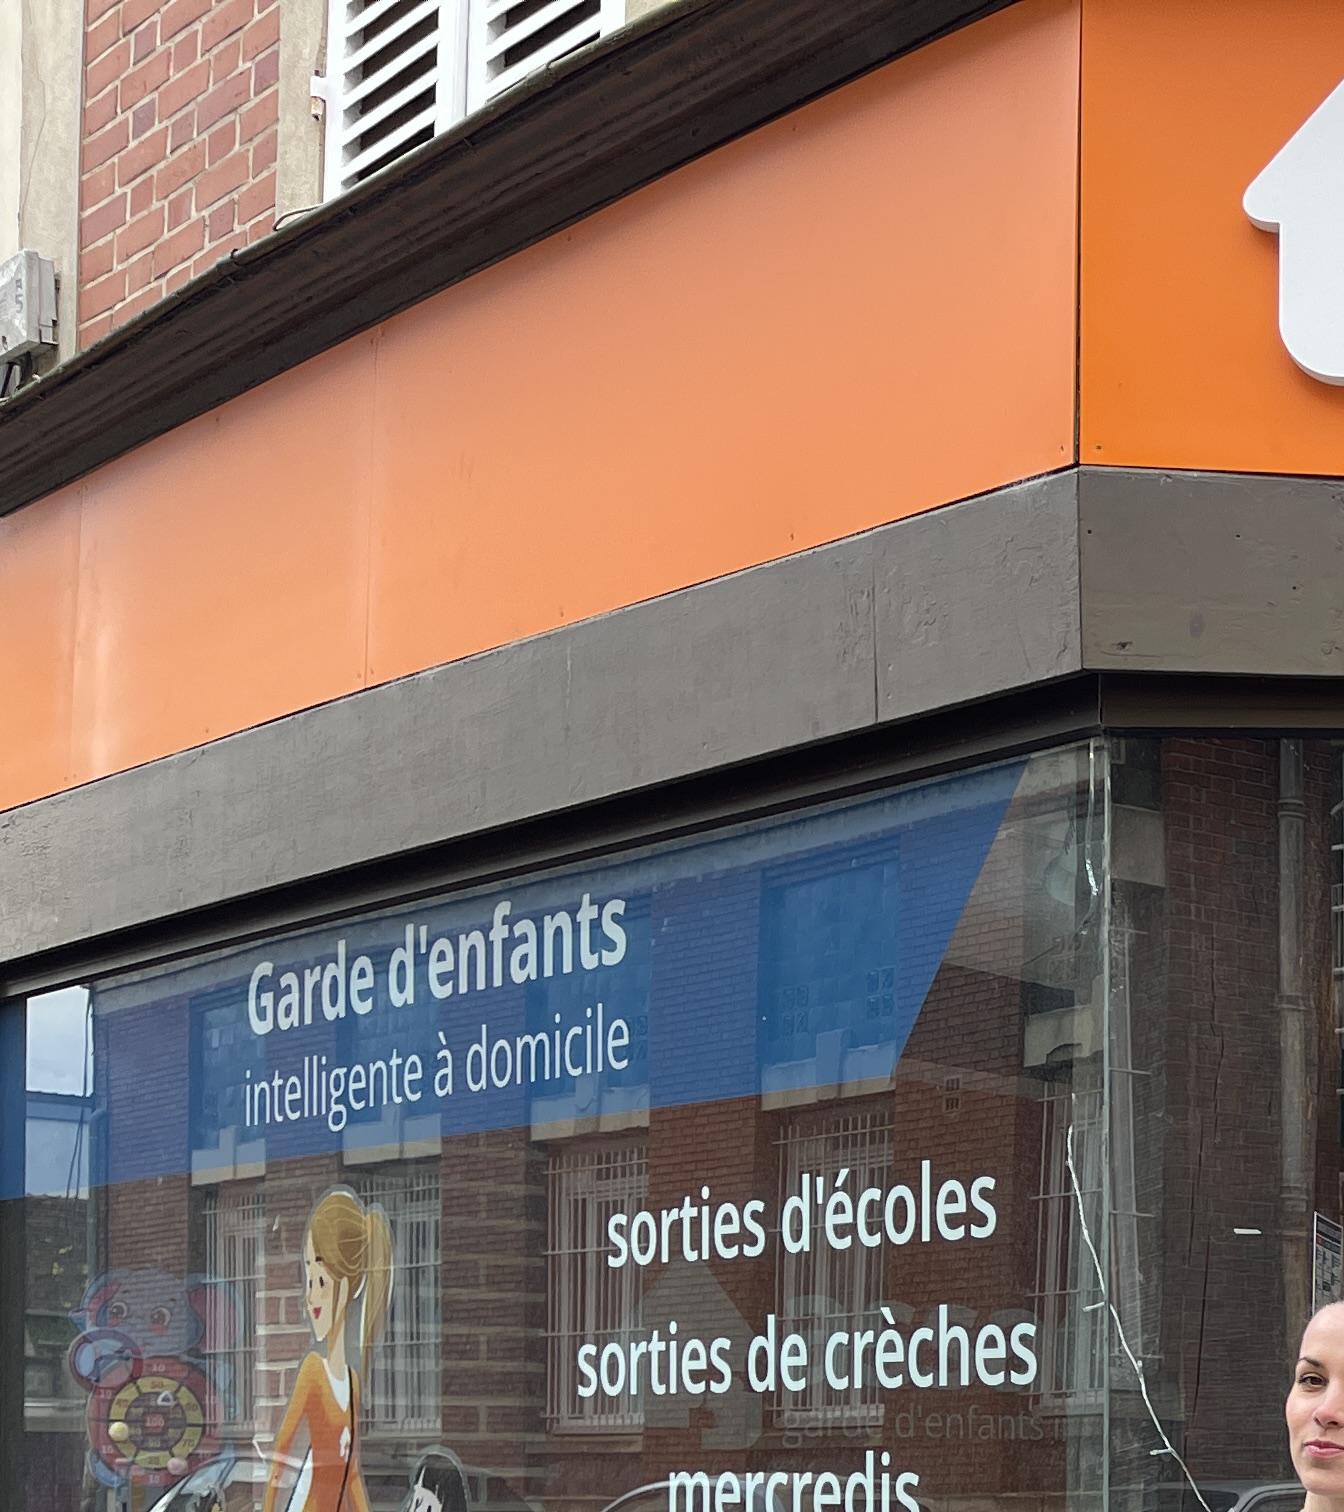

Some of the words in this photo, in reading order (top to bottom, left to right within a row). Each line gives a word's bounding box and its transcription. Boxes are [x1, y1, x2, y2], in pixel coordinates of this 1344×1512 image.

[247, 939, 374, 1036] Garde
[388, 893, 627, 1007] d'enfants
[244, 1047, 422, 1133] intelligente
[434, 1031, 453, 1097] à
[466, 1003, 630, 1092] domicile
[607, 1186, 765, 1268] sorties
[782, 1159, 996, 1254] d'écoles
[577, 1320, 732, 1397] sorties
[748, 1315, 807, 1393] de
[824, 1304, 1037, 1390] crèches
